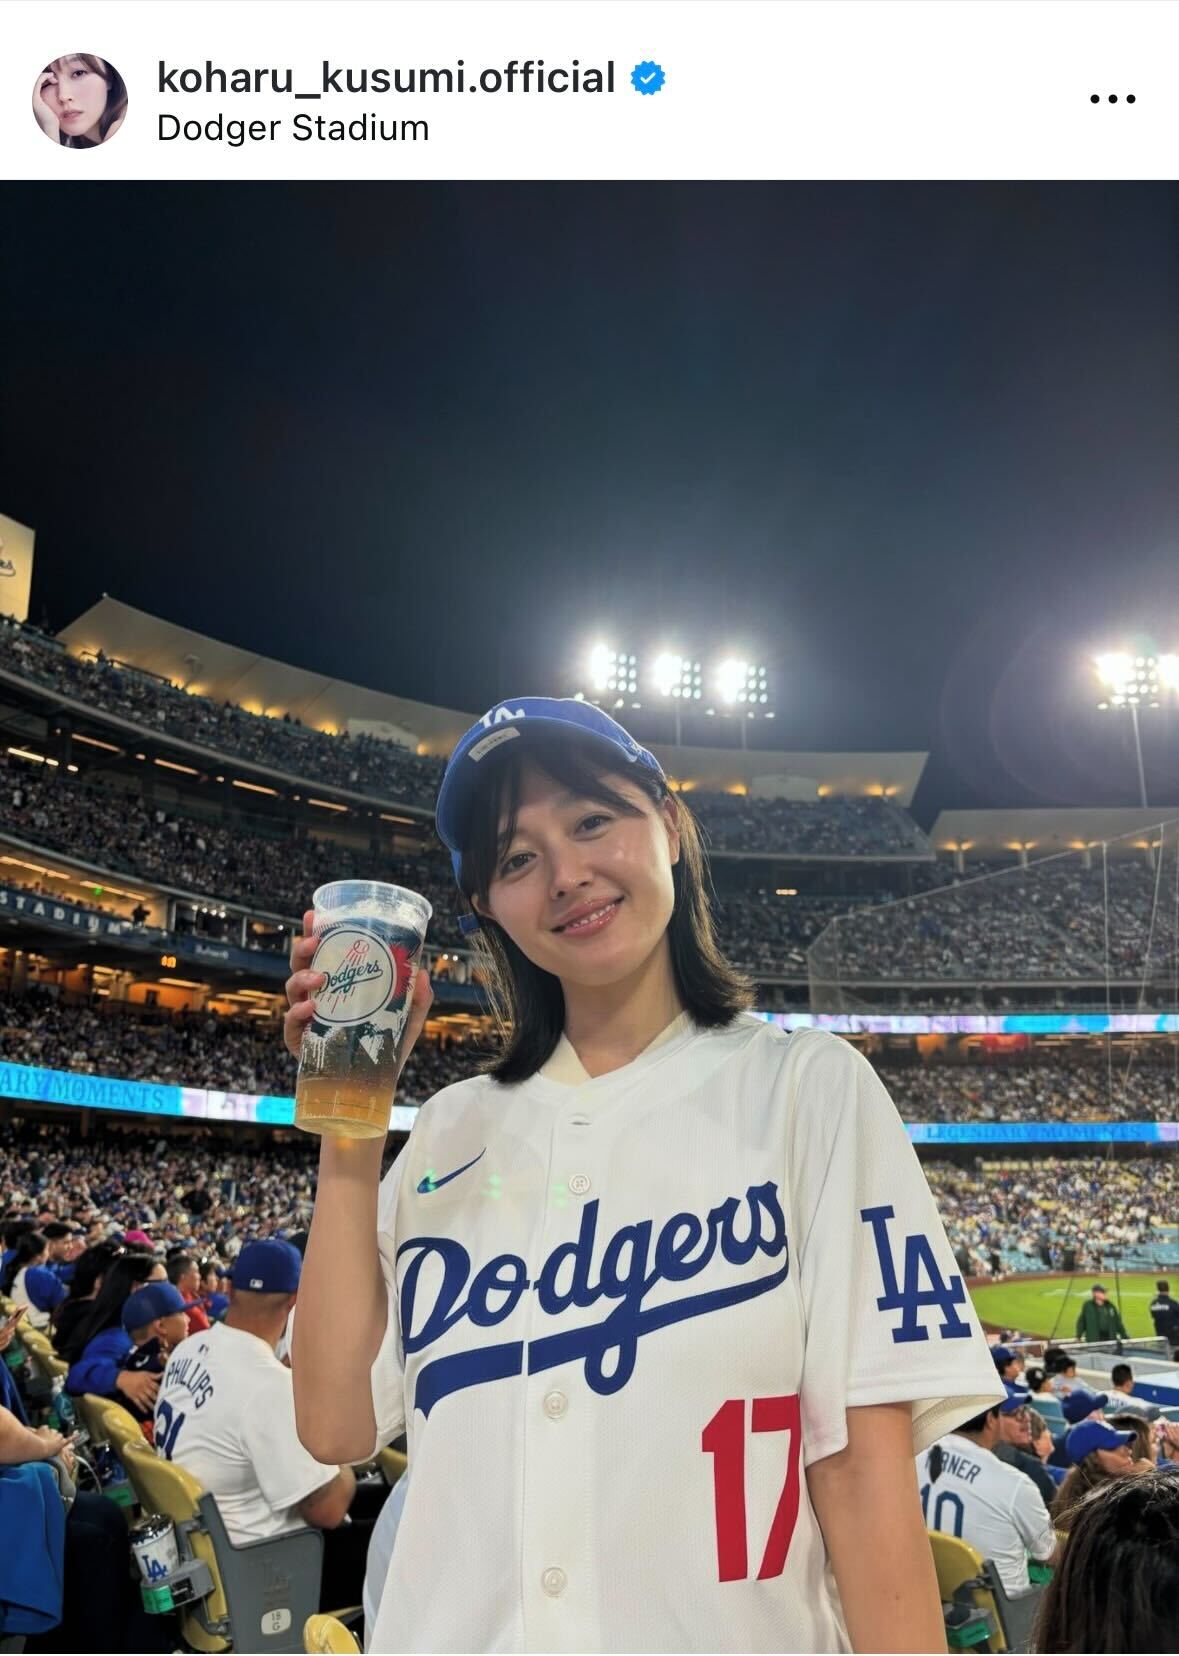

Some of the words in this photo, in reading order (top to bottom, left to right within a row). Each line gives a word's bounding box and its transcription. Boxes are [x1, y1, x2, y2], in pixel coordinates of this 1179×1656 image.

[315, 959, 383, 998] Dodgers
[51, 1074, 165, 1111] MOMENTS
[396, 1181, 789, 1397] Dodgers
[860, 1205, 972, 1343] LA
[164, 1358, 214, 1409] PHILLIPS
[702, 1393, 799, 1582] 17
[142, 1553, 168, 1583] LA
